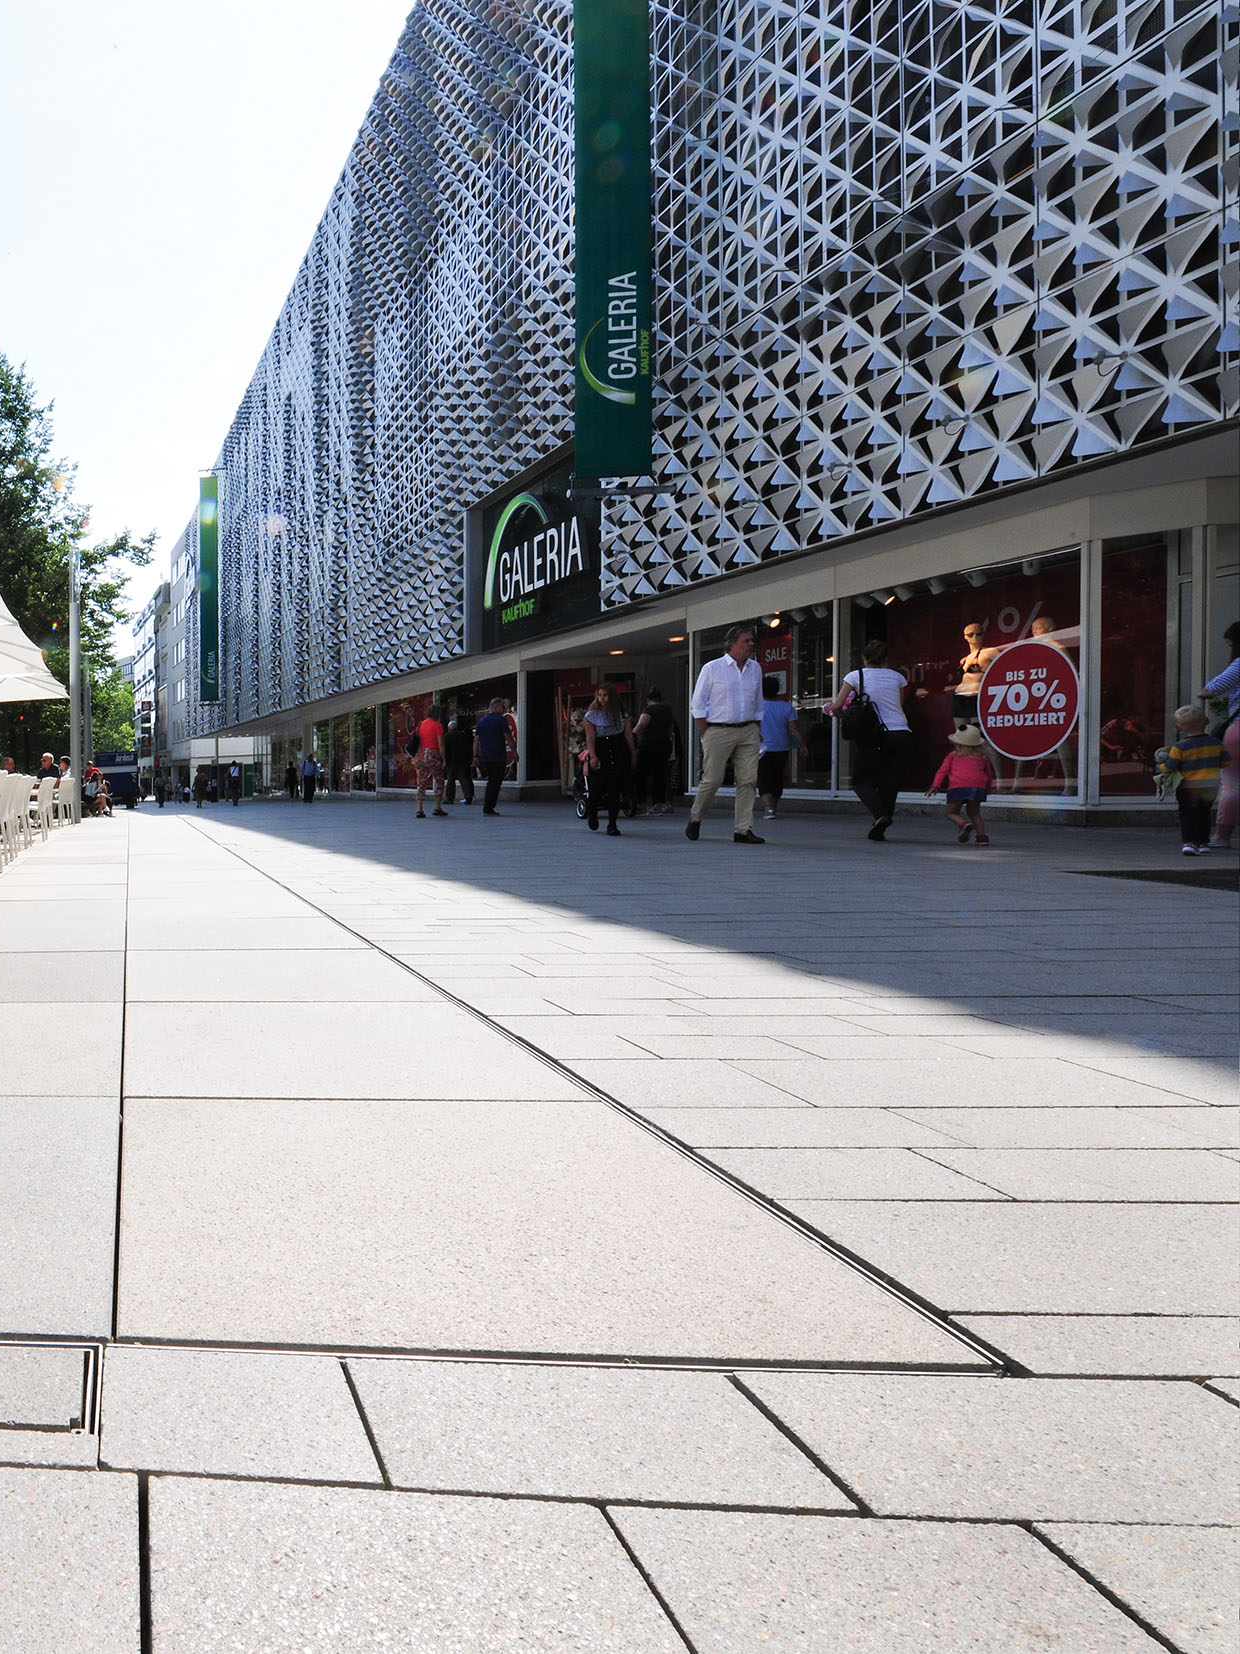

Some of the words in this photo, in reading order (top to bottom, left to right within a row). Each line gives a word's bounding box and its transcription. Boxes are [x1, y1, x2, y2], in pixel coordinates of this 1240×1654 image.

[607, 271, 637, 380] GALERIA
[500, 516, 583, 603] GALERIA
[207, 651, 216, 677] GALERIA
[765, 647, 787, 662] SALE
[1006, 669, 1025, 682] BIS
[1029, 668, 1047, 680] ZU
[987, 679, 1067, 713] 70%
[987, 711, 1066, 728] REDUZIERT
